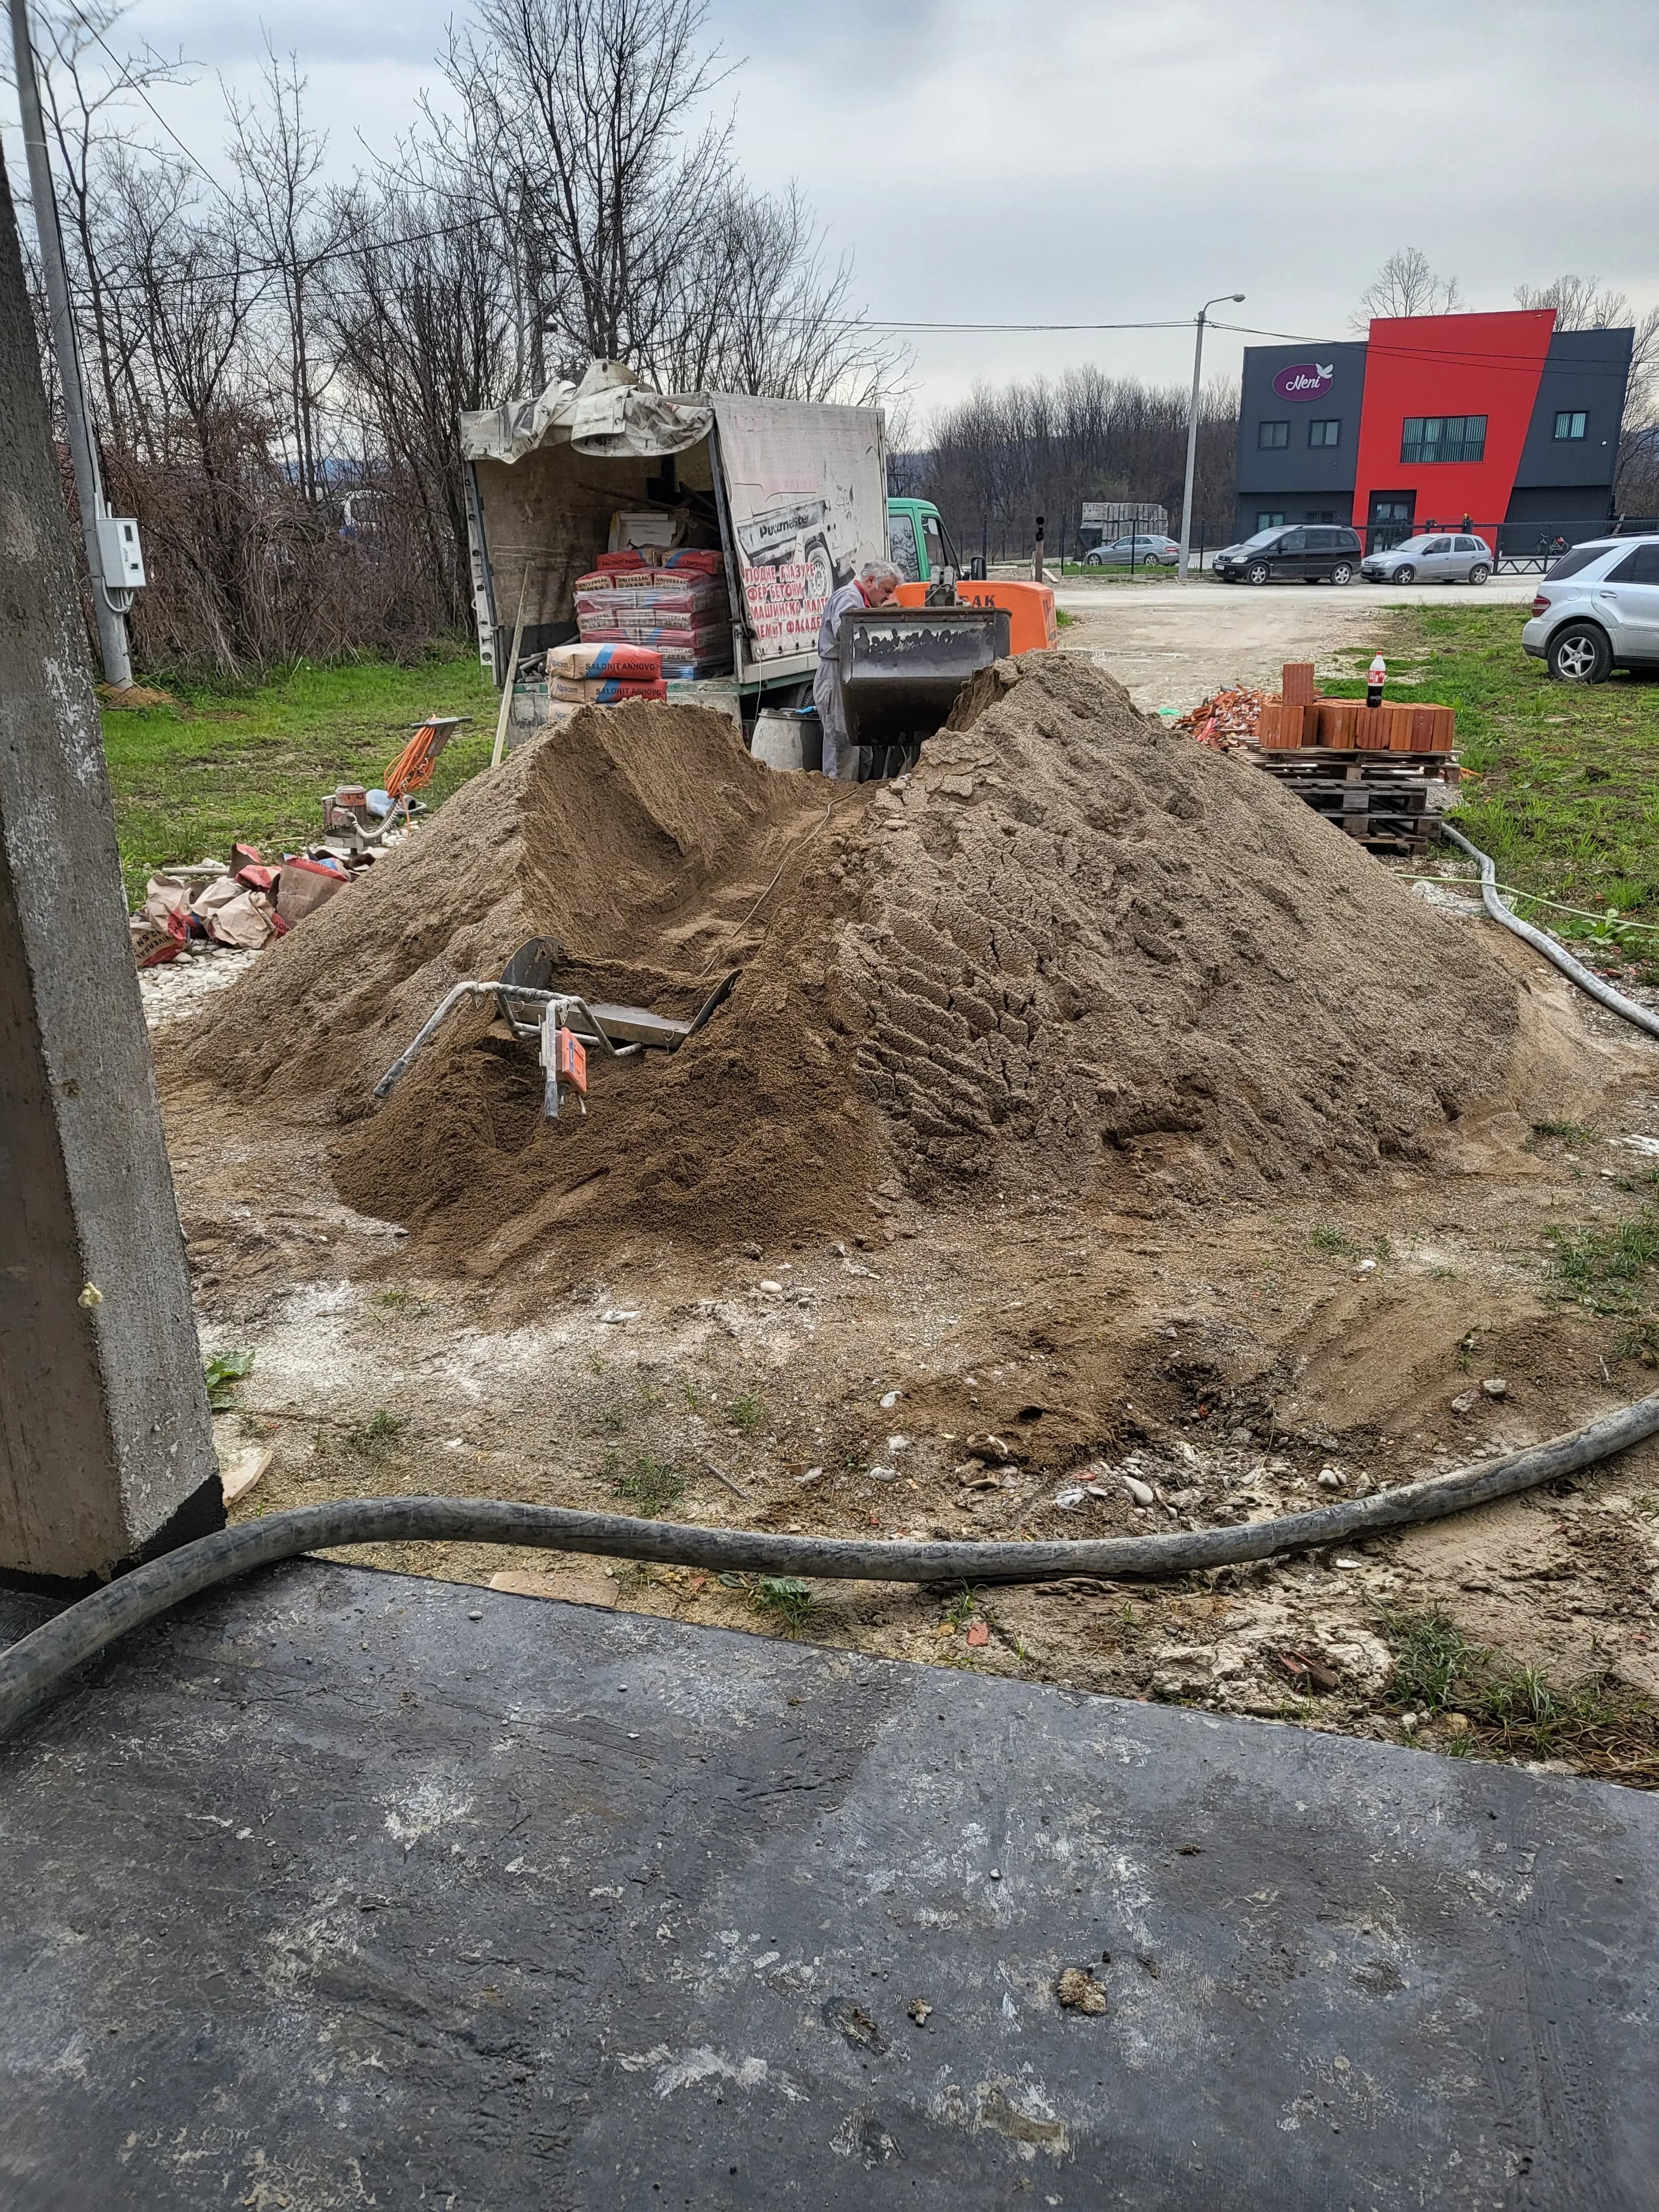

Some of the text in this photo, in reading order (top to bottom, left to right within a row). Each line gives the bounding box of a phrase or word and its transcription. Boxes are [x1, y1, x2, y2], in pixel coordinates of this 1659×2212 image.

[1286, 374, 1320, 390] Neni
[745, 566, 775, 582] ПОДНЕ
[578, 578, 608, 587] UNIVERSAL
[747, 586, 766, 601] ФЕР
